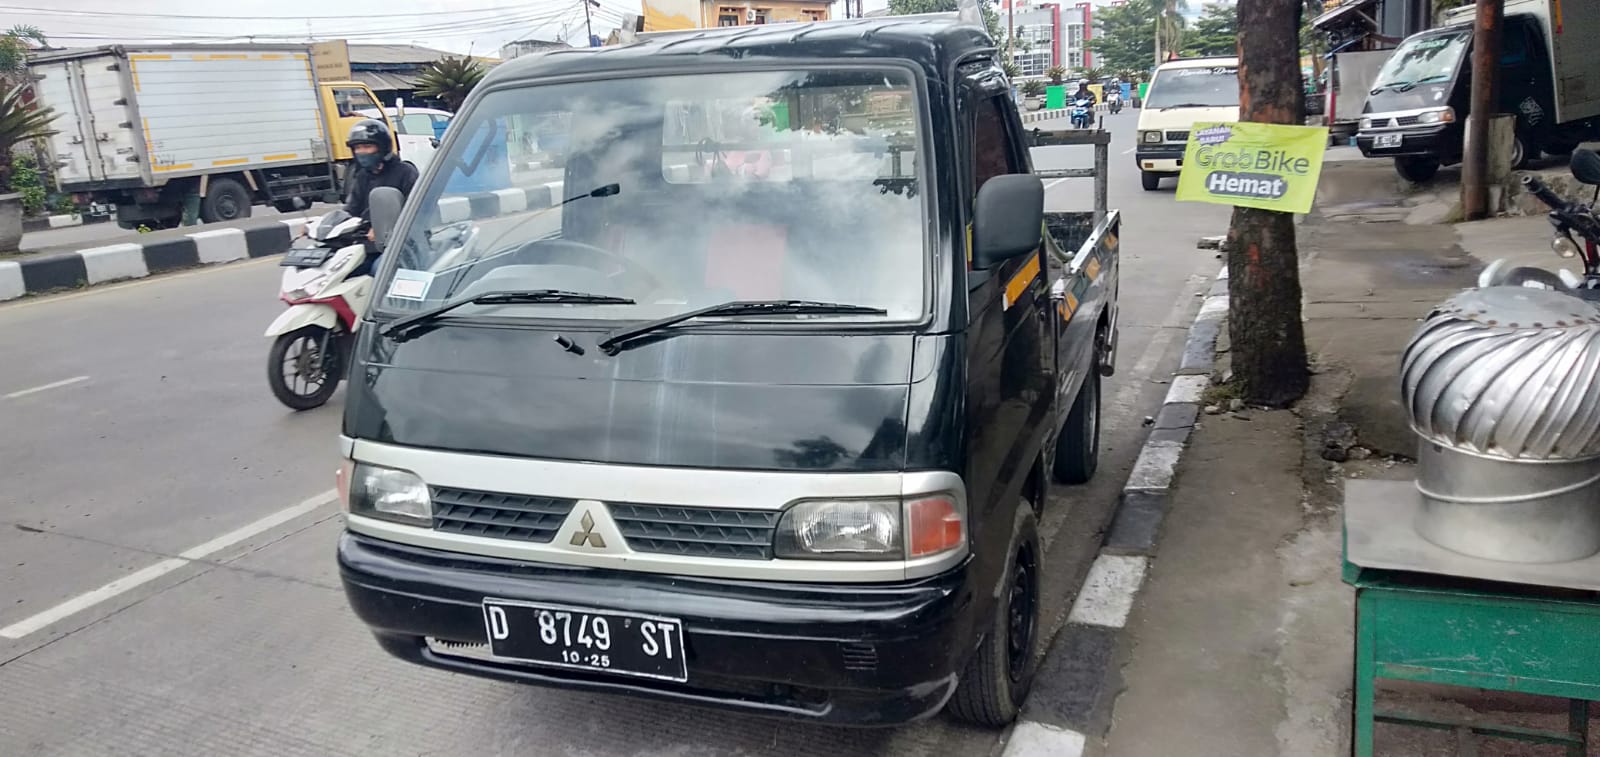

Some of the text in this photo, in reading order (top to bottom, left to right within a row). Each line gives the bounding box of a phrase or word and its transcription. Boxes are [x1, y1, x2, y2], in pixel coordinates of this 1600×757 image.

[1195, 144, 1310, 174] GrabBike
[1209, 173, 1283, 196] Hemat
[488, 605, 675, 660] D 8749 ST
